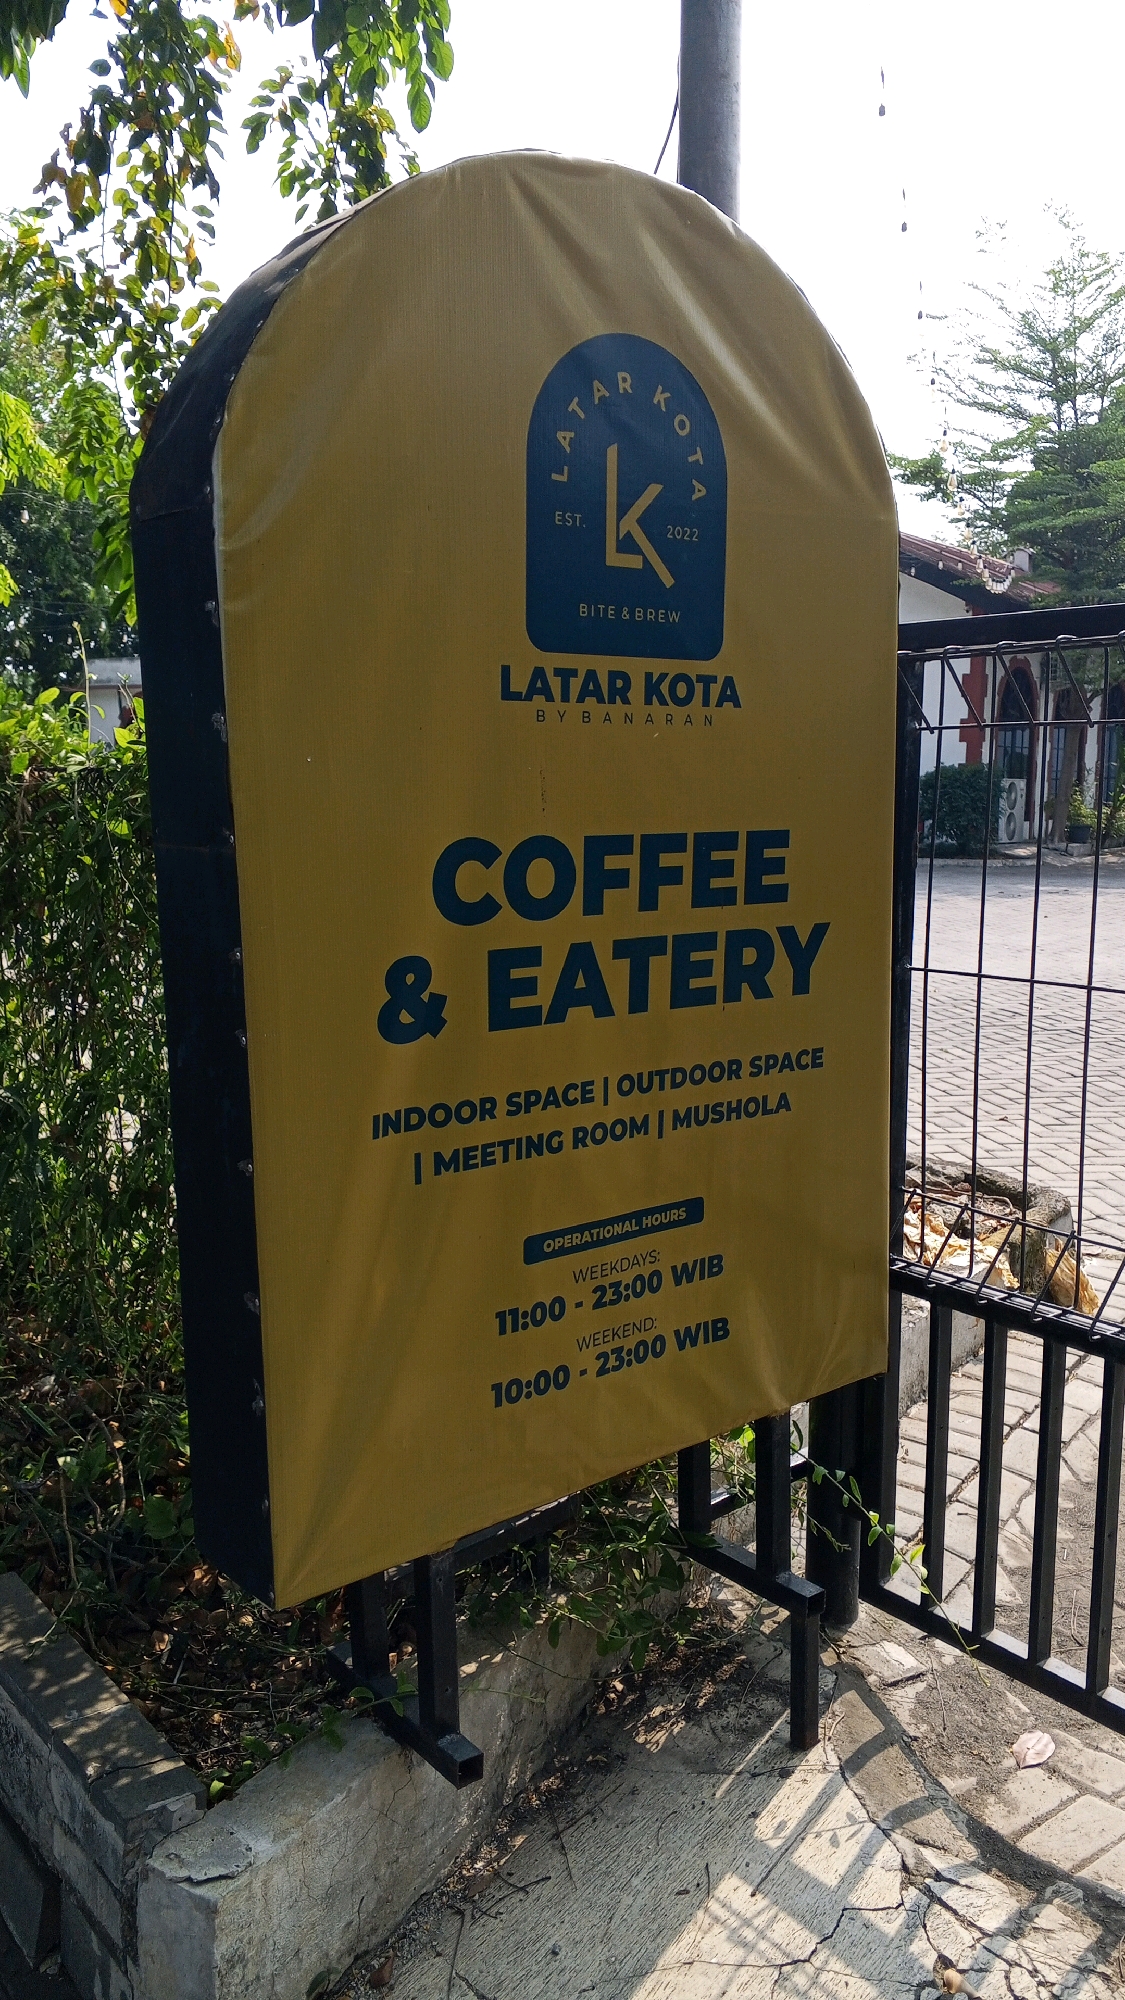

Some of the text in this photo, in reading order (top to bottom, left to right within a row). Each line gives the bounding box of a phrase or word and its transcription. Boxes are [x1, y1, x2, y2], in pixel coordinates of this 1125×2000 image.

[551, 371, 707, 500] LATAR KOTA
[555, 511, 586, 528] EST.
[667, 525, 699, 541] 2022
[579, 604, 681, 623] BITE & BREW
[500, 664, 742, 708] LATAR KOTA
[536, 709, 713, 727] BY BANARAN
[432, 829, 790, 926] COFFEE
[377, 922, 831, 1045] & EATERY
[371, 1097, 498, 1140] INDOOR
[505, 1079, 595, 1117] SPACE
[616, 1058, 742, 1098] OUTDOOR
[748, 1047, 824, 1079] SPACE
[433, 1130, 564, 1177] MEETING
[572, 1114, 650, 1150] ROOM
[671, 1091, 792, 1132] MUSHOLA
[543, 1207, 687, 1253] OPERATIONAL HOURS
[572, 1249, 660, 1284] WEEKDAYS:
[495, 1295, 566, 1336] 11:00
[591, 1269, 663, 1310] 23:00
[670, 1254, 724, 1287] WIB
[576, 1317, 657, 1352] WEEKEND:
[490, 1364, 570, 1408] 10:00
[595, 1334, 666, 1377] 23:00
[673, 1317, 730, 1351] WIB
